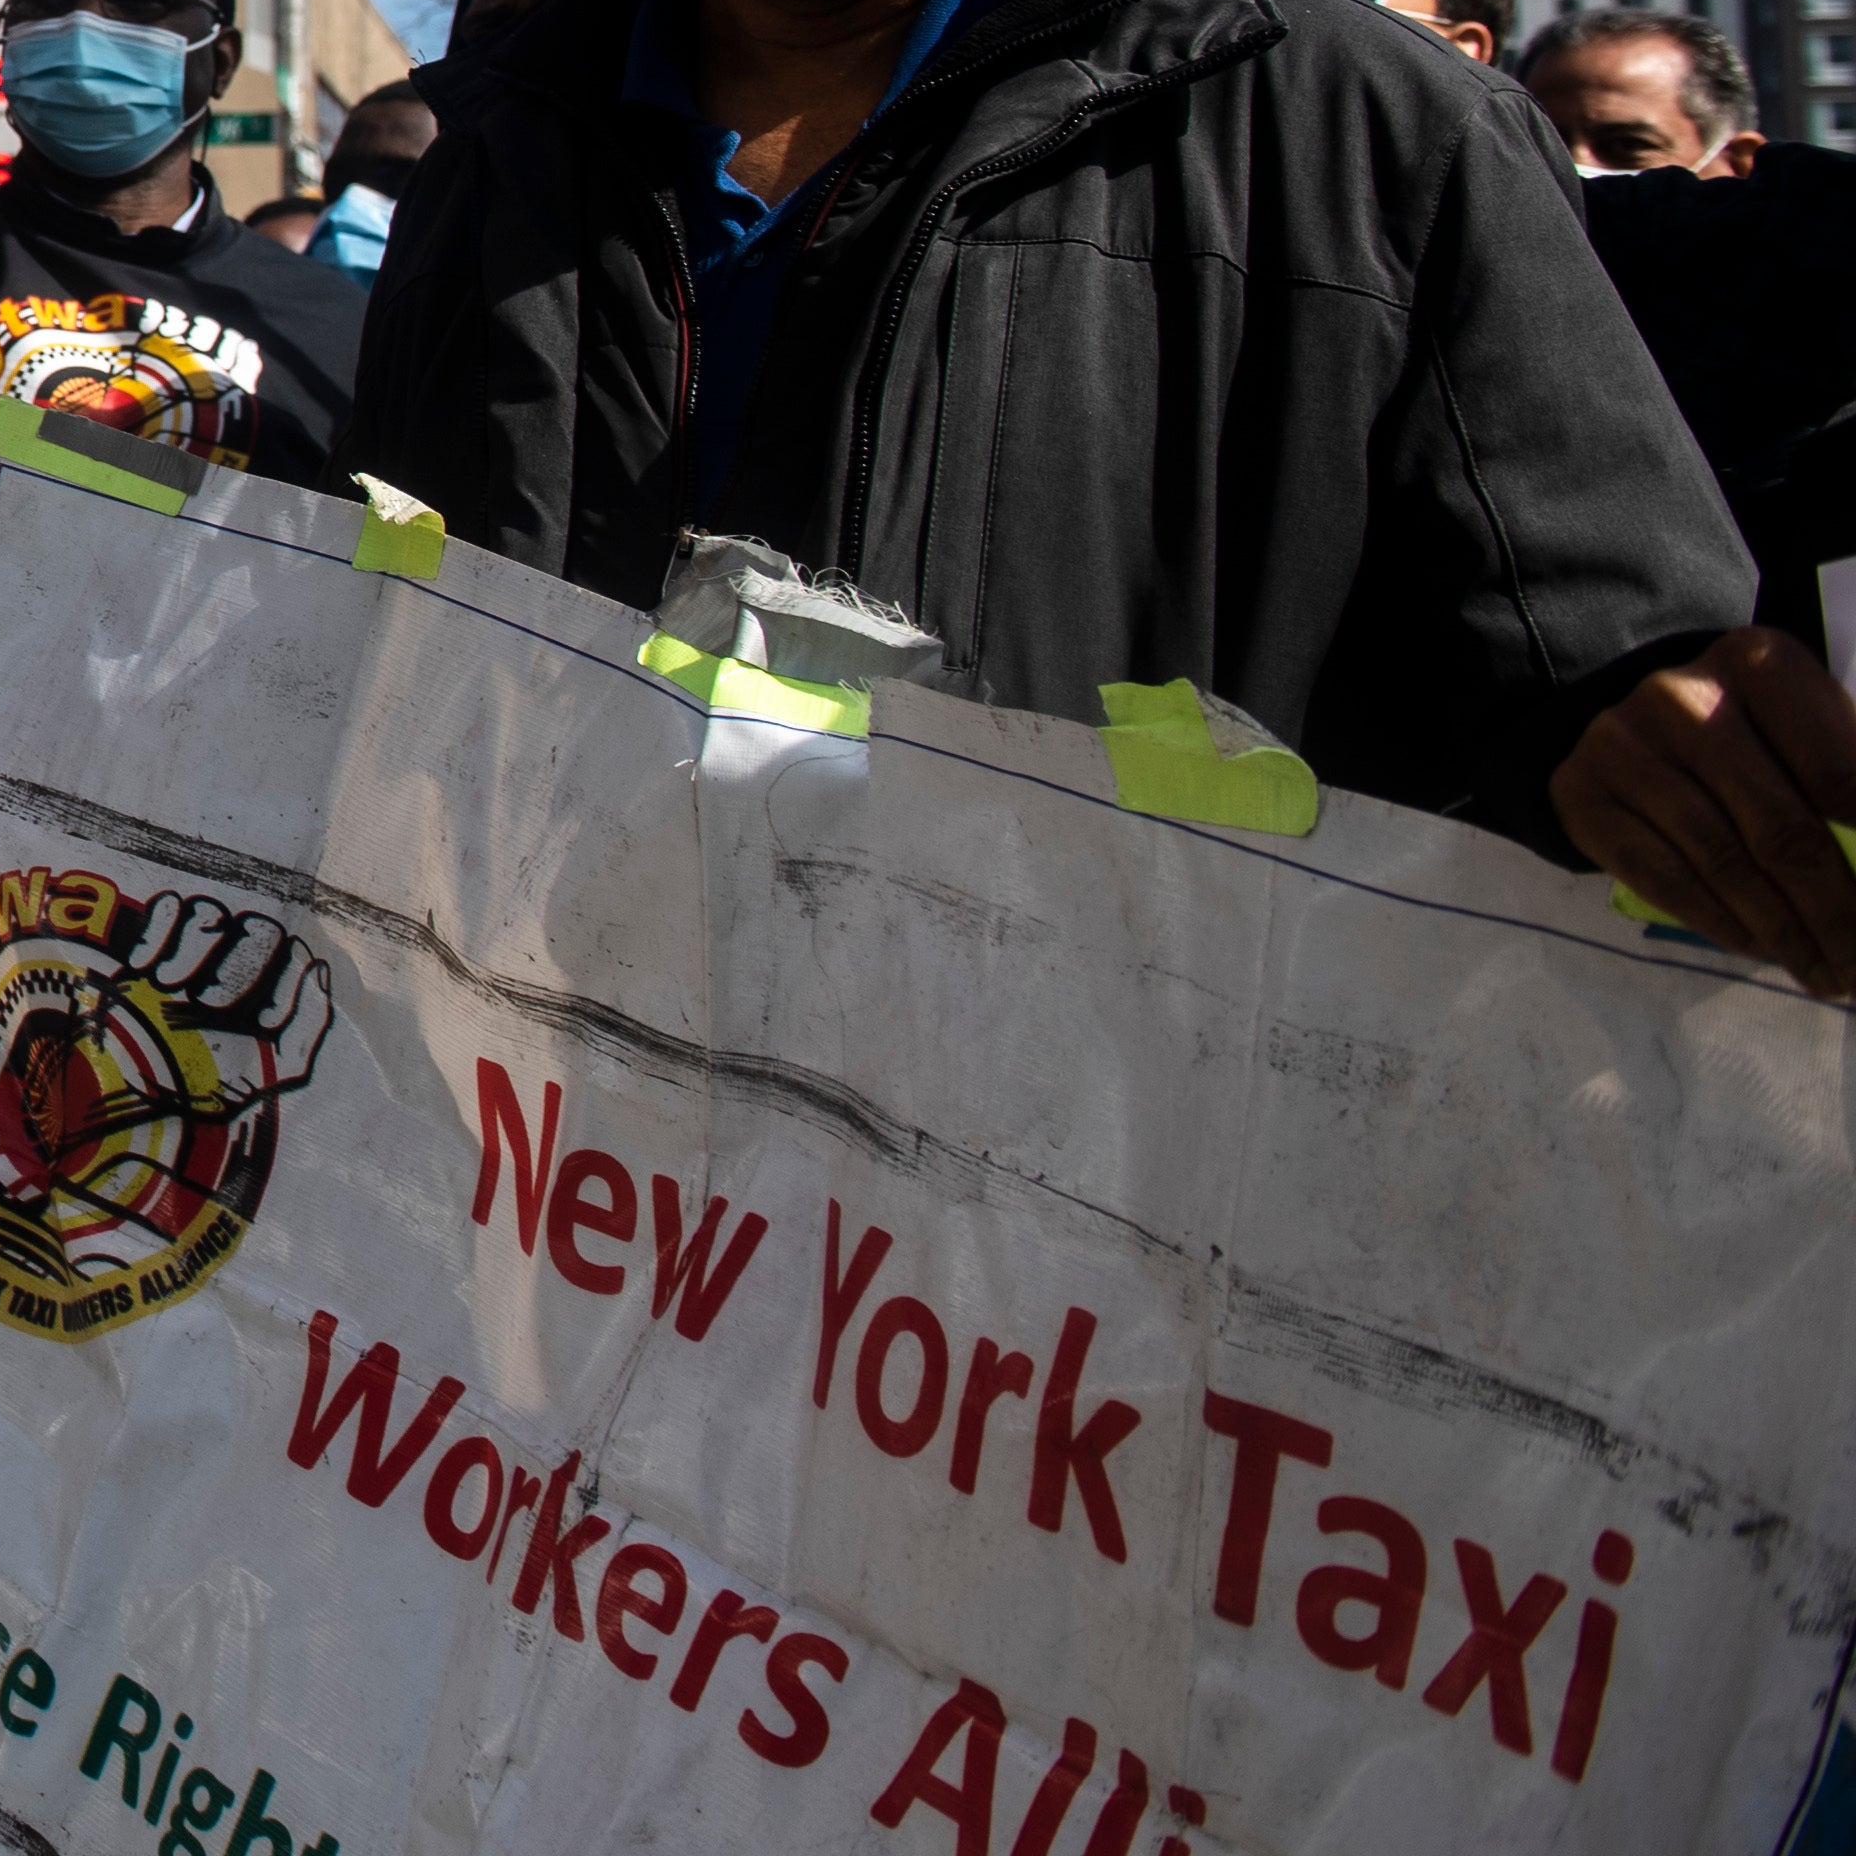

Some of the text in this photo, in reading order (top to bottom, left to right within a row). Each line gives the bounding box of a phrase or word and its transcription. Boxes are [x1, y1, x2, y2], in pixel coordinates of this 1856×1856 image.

[8, 1285, 60, 1332] TAXI
[139, 1207, 245, 1307] ALLIANCE
[472, 1057, 1637, 1784] New York Taxi
[287, 1308, 850, 1770] Workers
